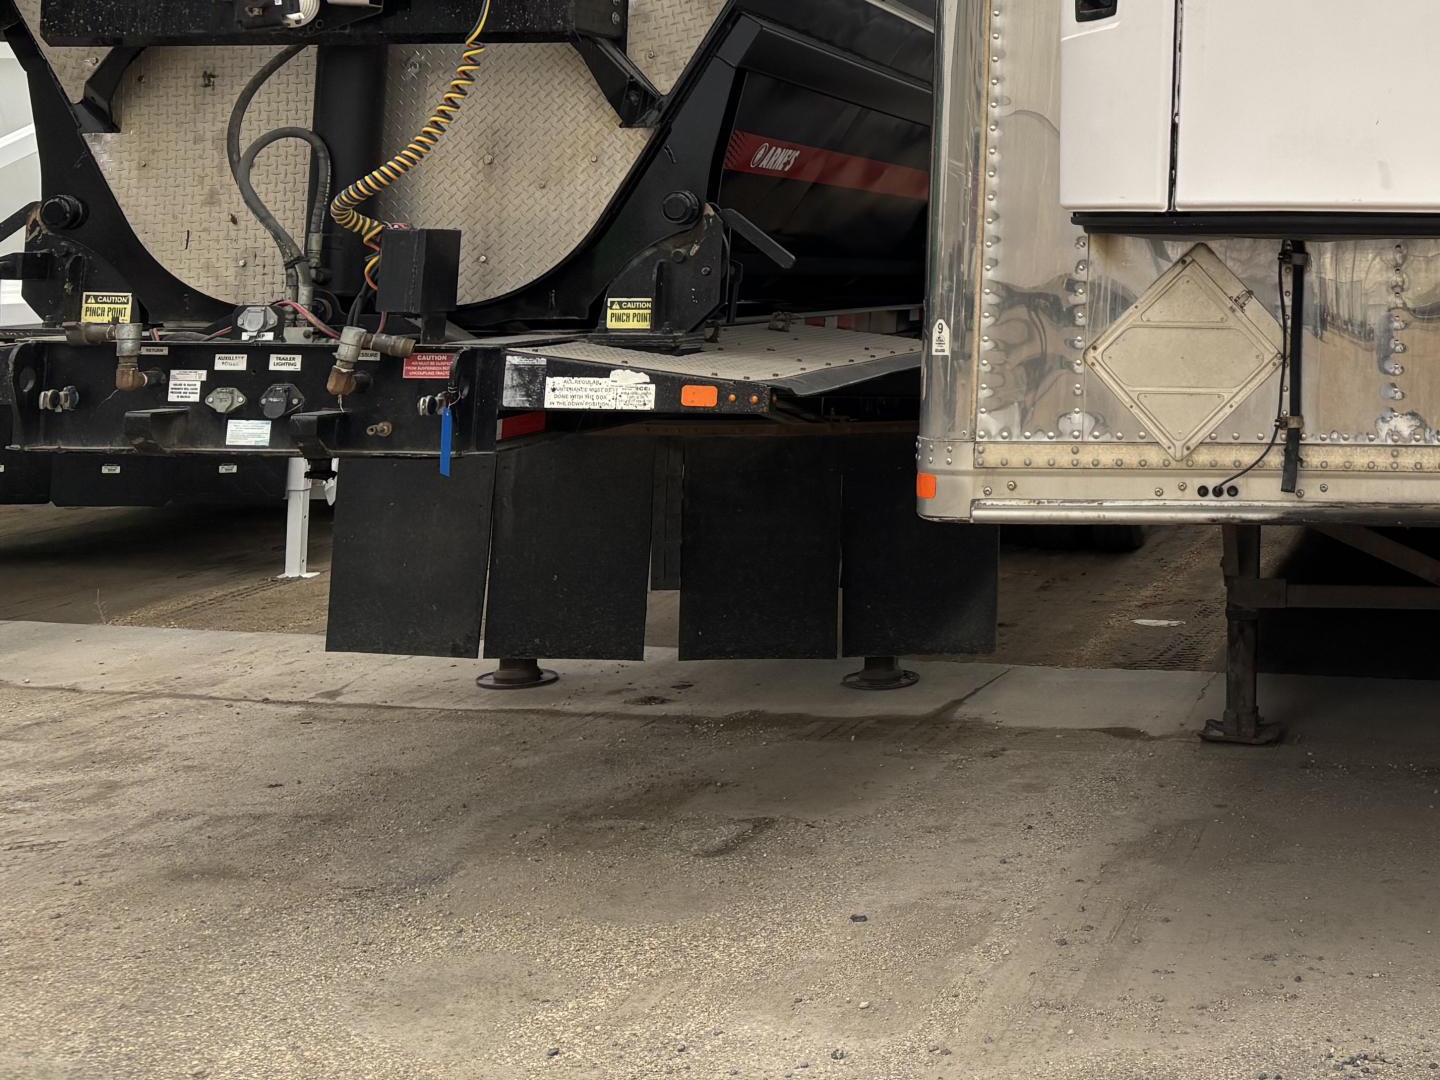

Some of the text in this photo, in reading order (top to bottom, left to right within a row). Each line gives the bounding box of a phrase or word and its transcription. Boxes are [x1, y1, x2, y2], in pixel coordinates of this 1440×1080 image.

[758, 146, 801, 172] ARNE'S
[97, 295, 128, 303] CAUTION
[621, 301, 652, 309] CAUTION
[85, 306, 127, 319] PINCH POINT
[610, 312, 651, 323] PINCH POINT
[937, 322, 944, 334] 9
